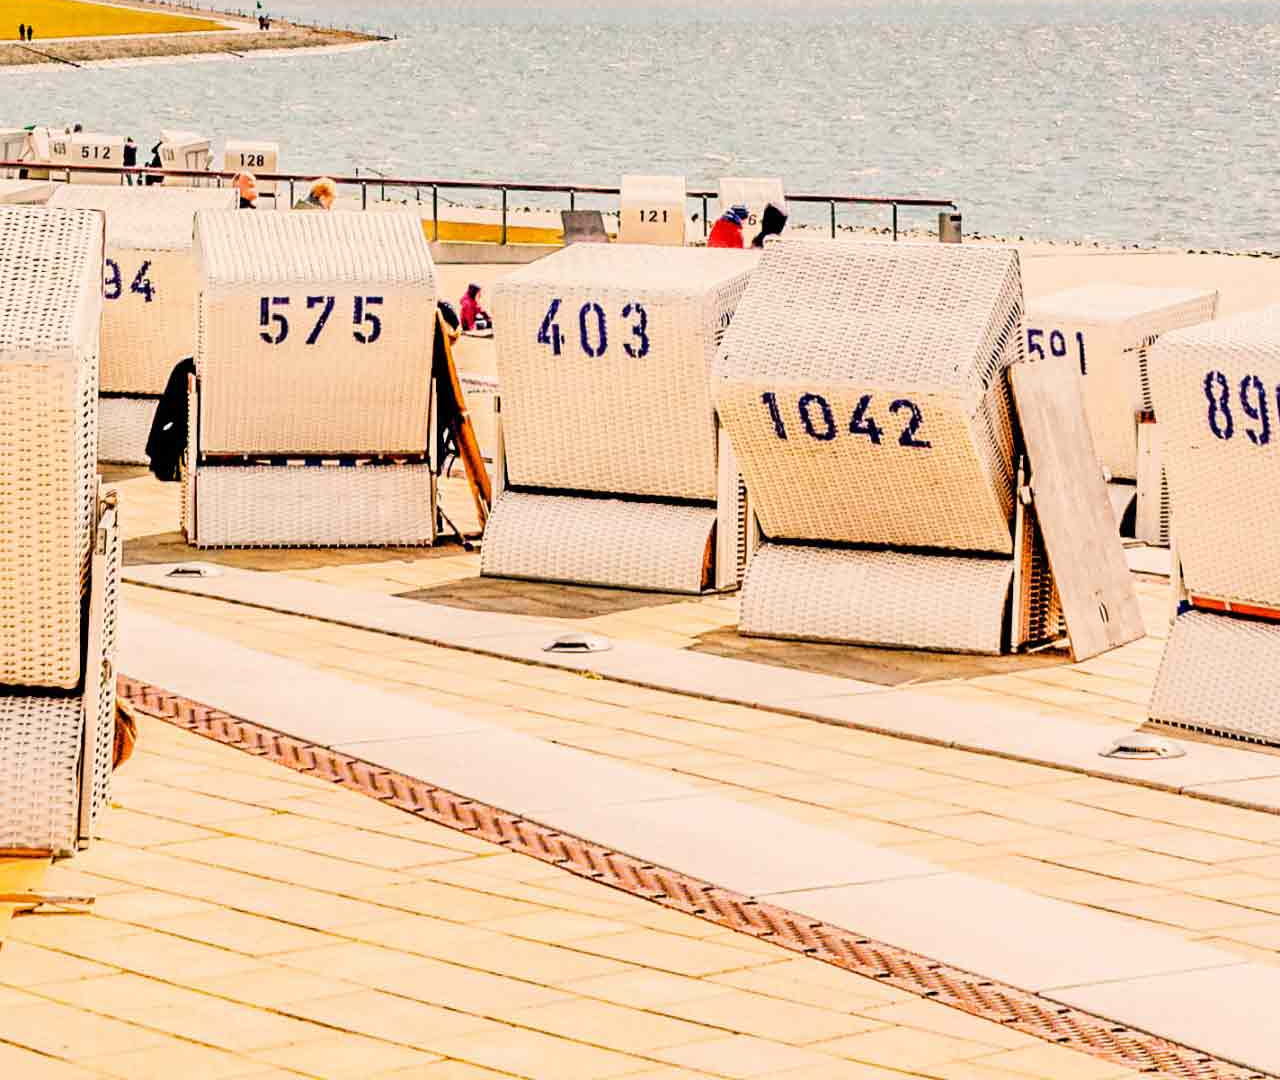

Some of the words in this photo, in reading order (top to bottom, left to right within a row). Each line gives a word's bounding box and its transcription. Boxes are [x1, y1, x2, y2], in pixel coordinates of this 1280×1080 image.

[81, 145, 111, 160] 512
[240, 153, 265, 167] 128
[638, 208, 668, 223] 121
[259, 295, 384, 345] 575
[537, 298, 650, 359] 403
[761, 391, 932, 448] 1042
